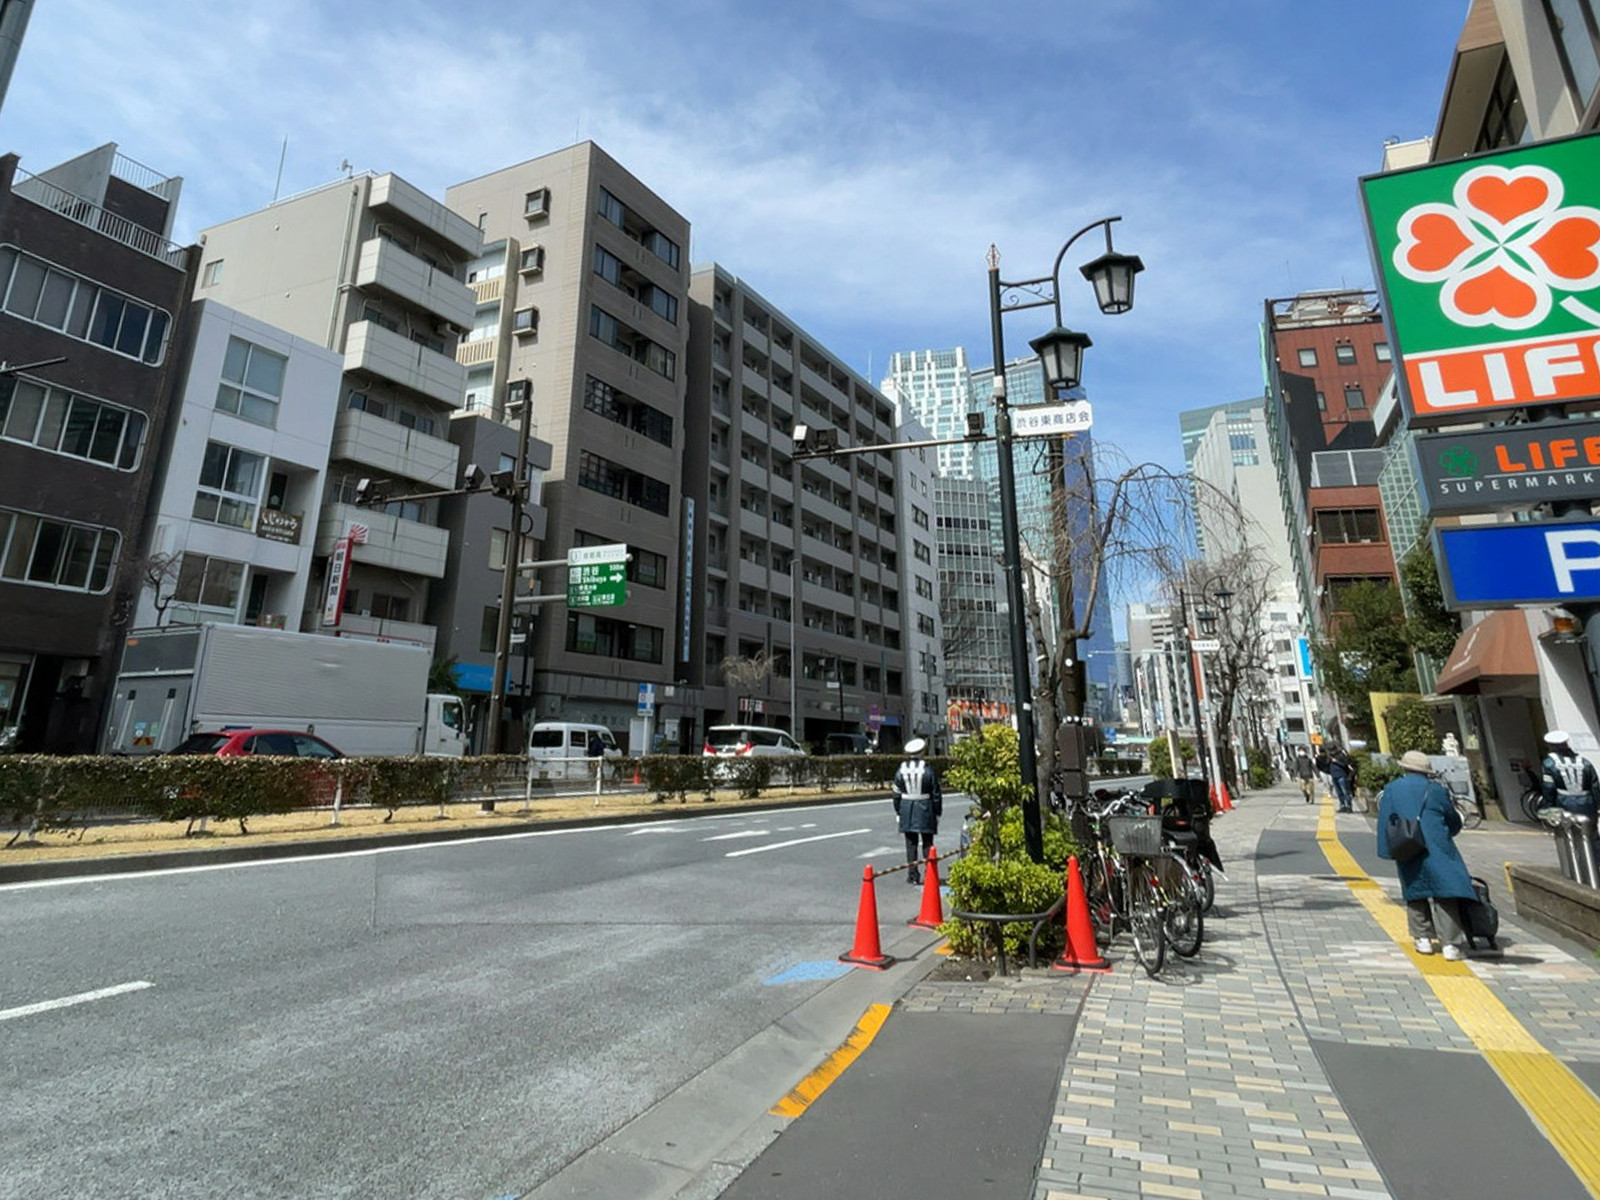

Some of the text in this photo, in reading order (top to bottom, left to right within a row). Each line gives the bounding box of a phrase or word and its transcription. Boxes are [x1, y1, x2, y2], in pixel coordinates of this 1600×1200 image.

[1417, 338, 1600, 408] LIF
[1016, 411, 1090, 429] 渋谷東商店会
[1494, 436, 1600, 473] LIFE
[582, 575, 607, 584] Shibuya
[1544, 529, 1600, 593] P
